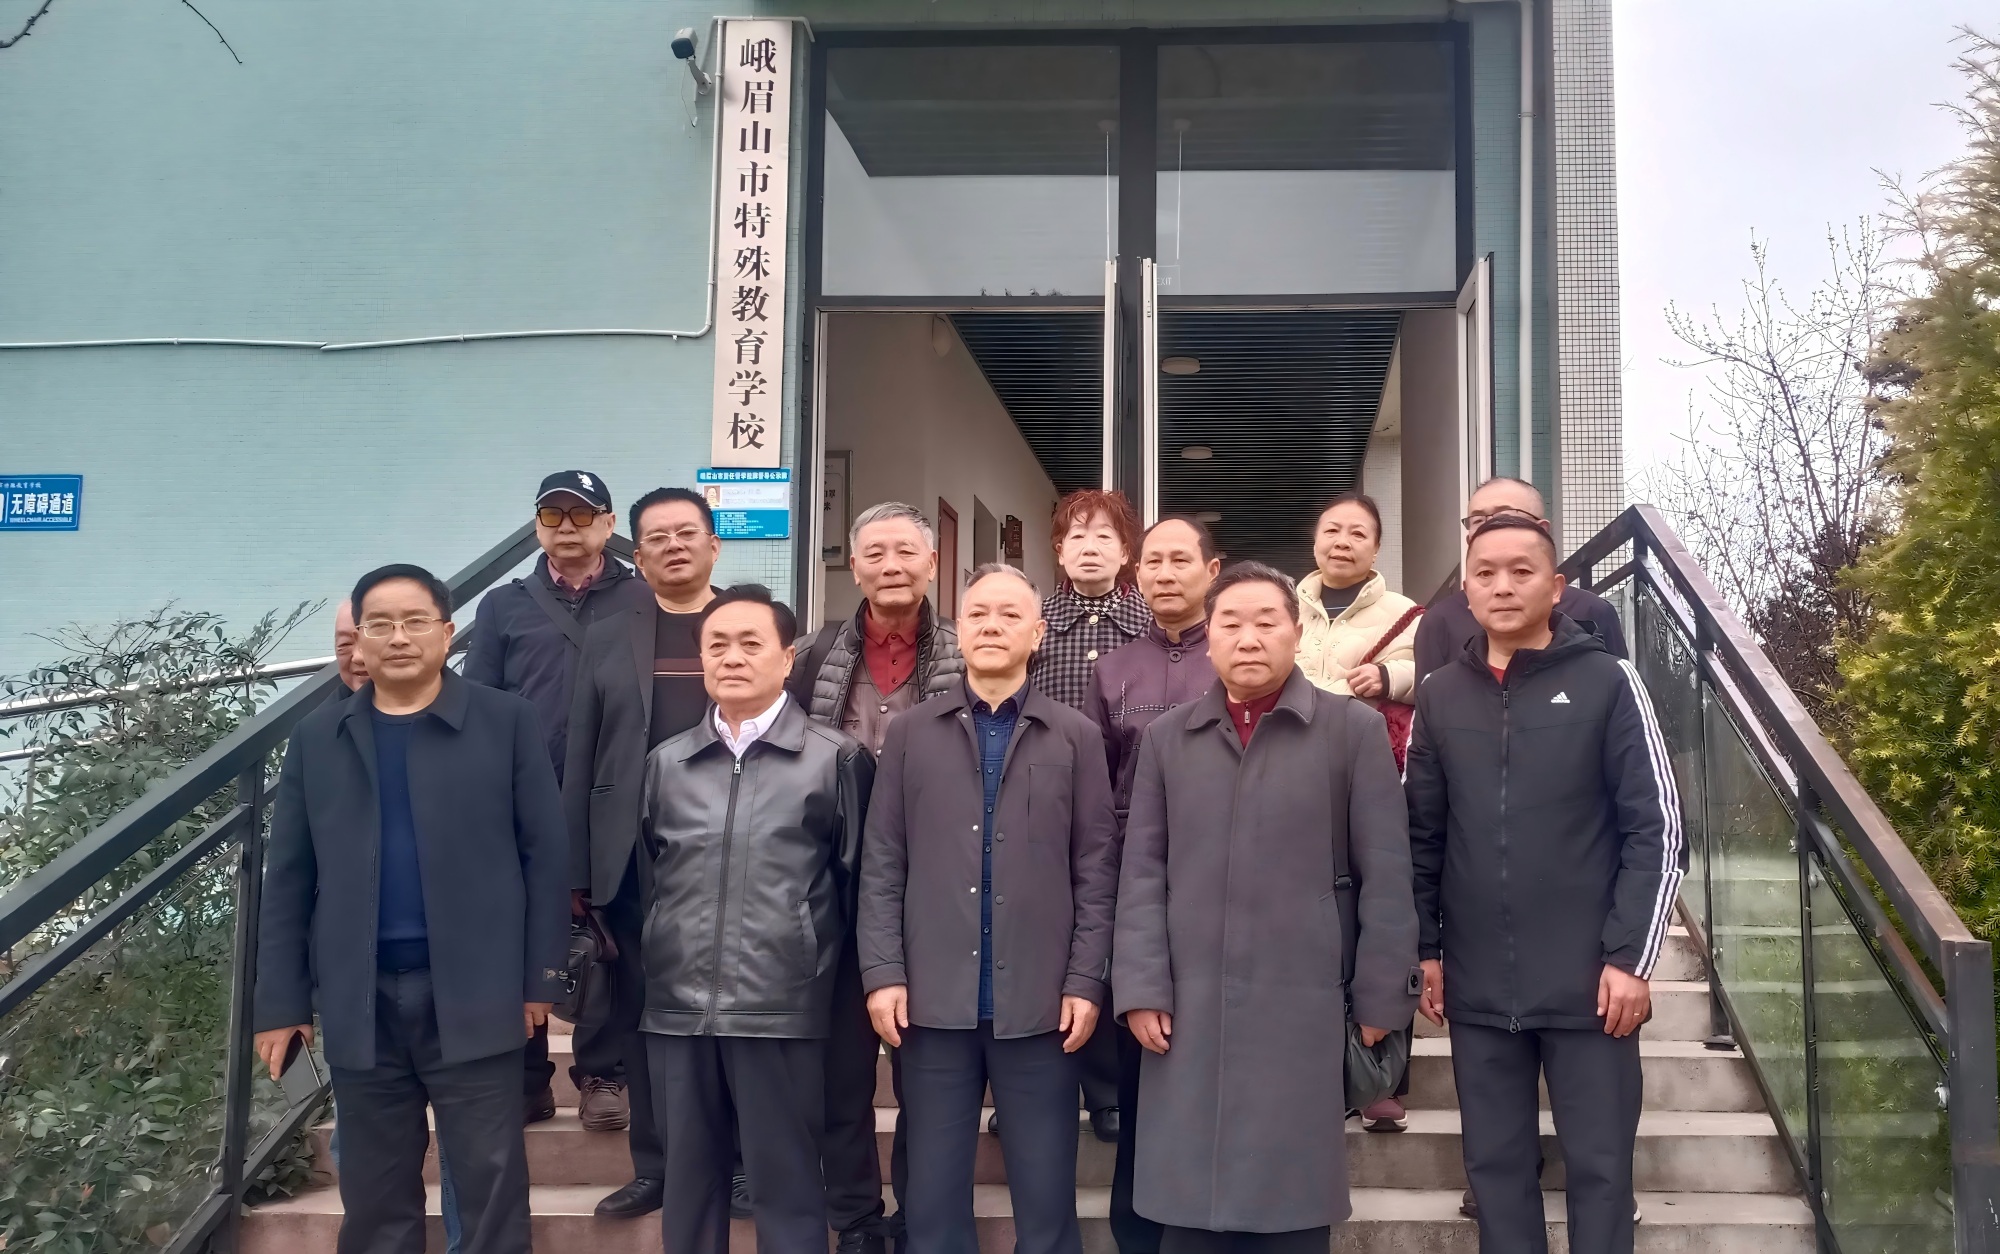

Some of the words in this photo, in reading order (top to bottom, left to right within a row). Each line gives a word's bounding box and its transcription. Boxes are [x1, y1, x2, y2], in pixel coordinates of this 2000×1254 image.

[727, 37, 777, 450] 峨眉山市特殊教育学校
[10, 493, 74, 515] 无障碍通道
